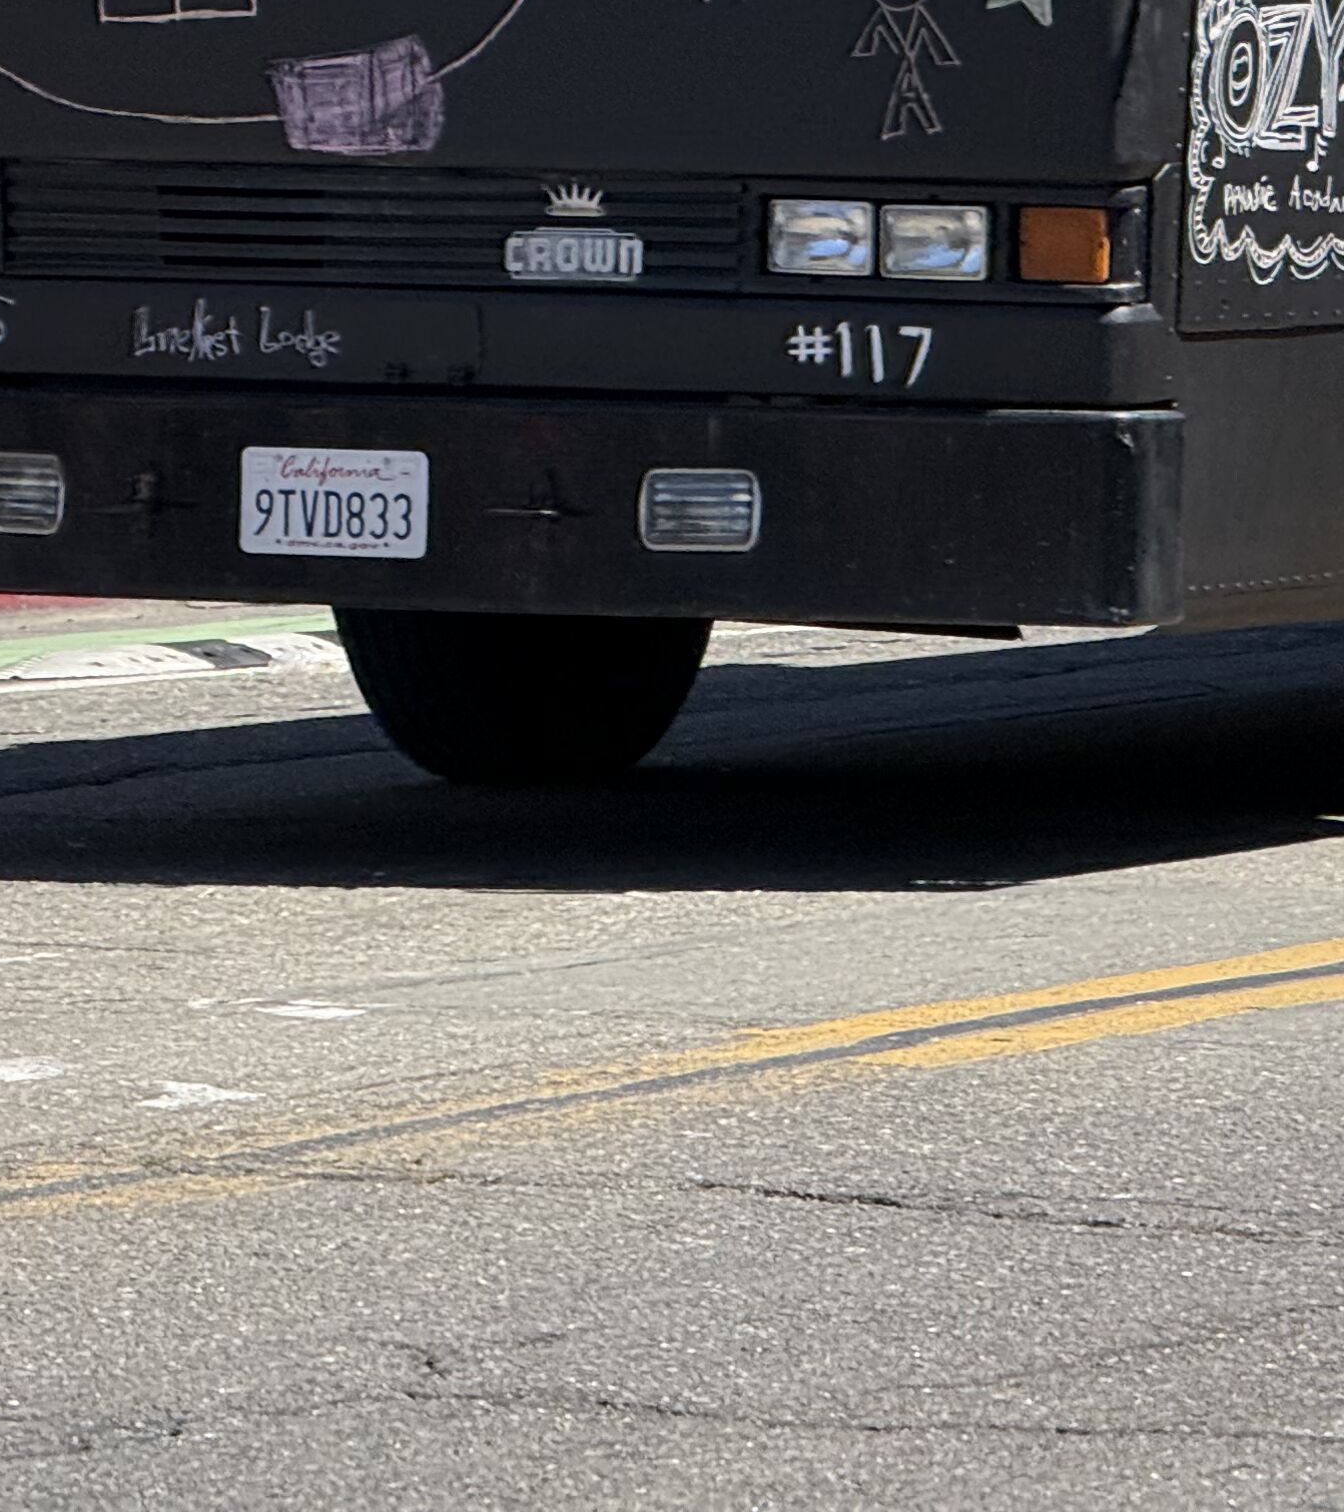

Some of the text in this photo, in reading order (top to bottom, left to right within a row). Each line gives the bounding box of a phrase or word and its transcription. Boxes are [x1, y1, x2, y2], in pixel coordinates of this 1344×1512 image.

[785, 321, 935, 386] #117
[280, 454, 395, 486] California
[253, 489, 413, 540] 9TVD833
